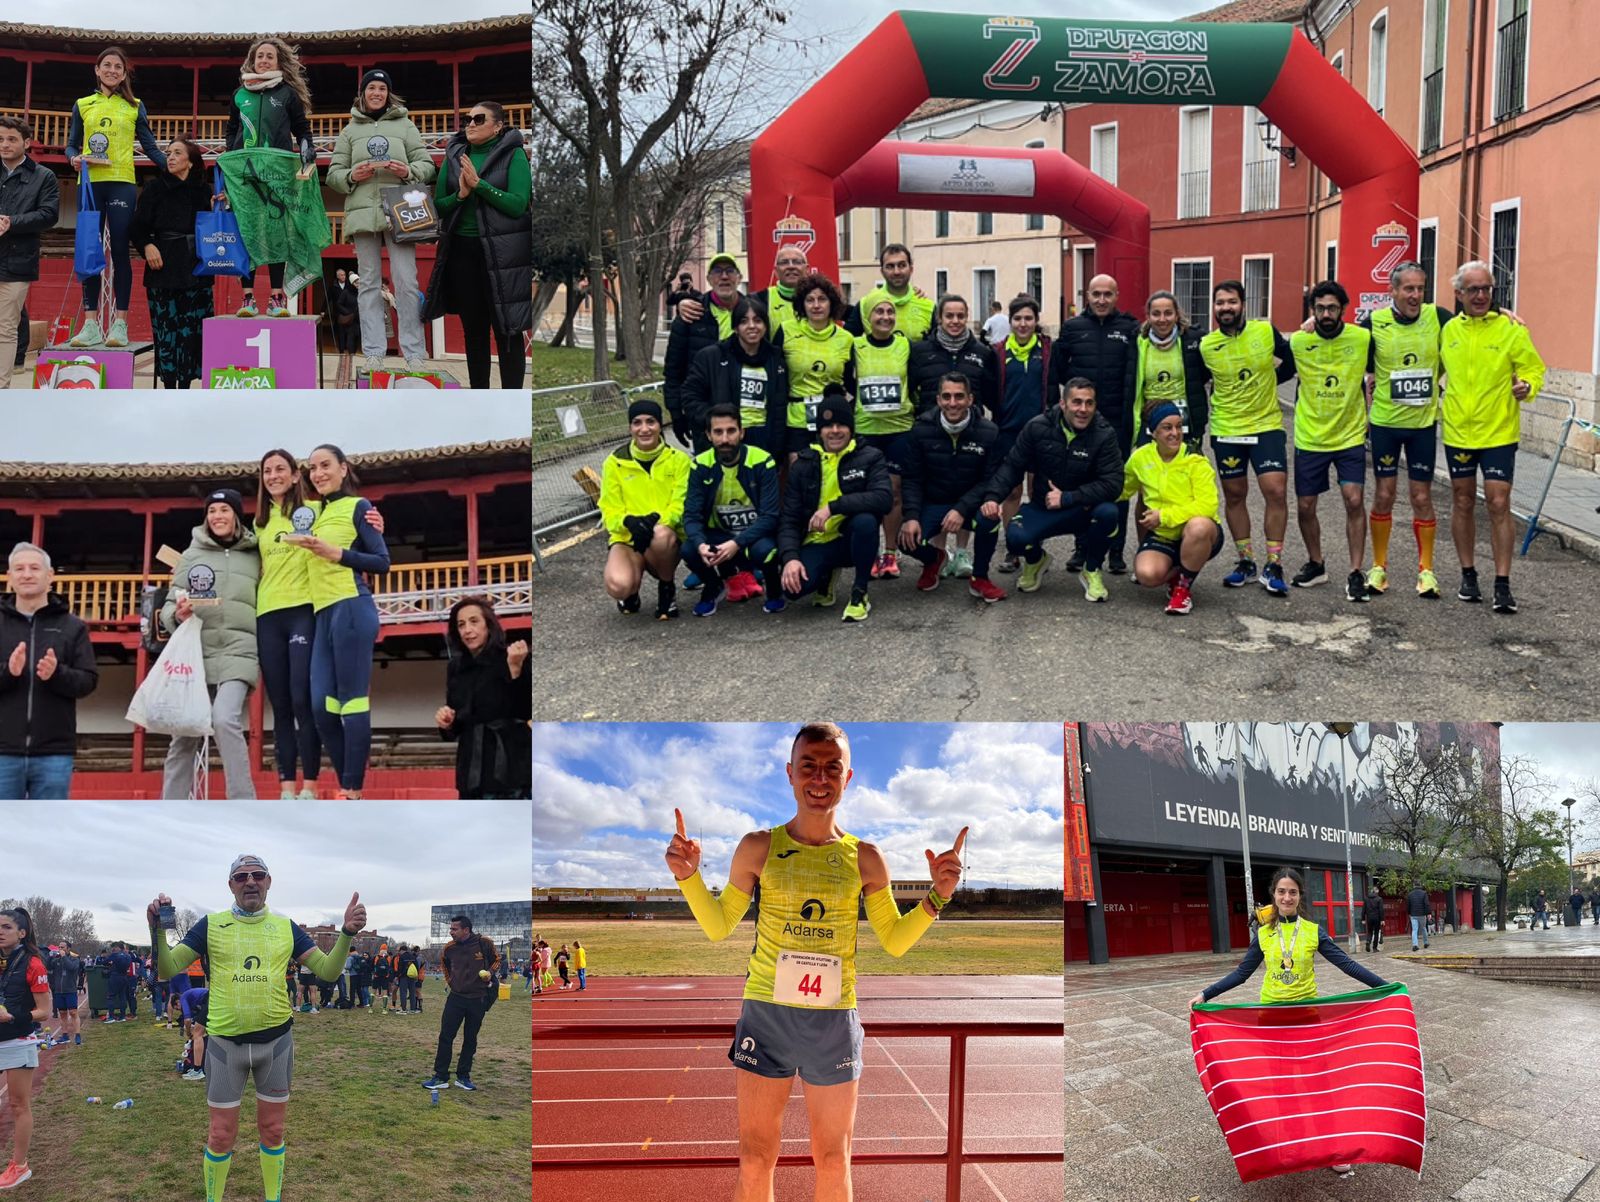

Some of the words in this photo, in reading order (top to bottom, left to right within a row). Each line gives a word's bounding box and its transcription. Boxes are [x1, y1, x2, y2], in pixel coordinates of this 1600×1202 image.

[1054, 61, 1216, 95] ZAMORA
[401, 206, 428, 224] Susi
[246, 329, 270, 368] 1
[215, 376, 271, 389] ZAMORA
[1395, 379, 1429, 393] 1046
[864, 386, 897, 399] 1314
[722, 511, 758, 526] 1219
[1248, 814, 1308, 839] BRAVURA
[1311, 825, 1319, 840] Y
[1320, 827, 1382, 848] SENTMIENTO
[1103, 904, 1125, 912] ERTA
[782, 922, 834, 939] Adarsa
[232, 974, 268, 983] Adarsa
[798, 973, 822, 997] 44
[734, 1051, 758, 1066] darsa
